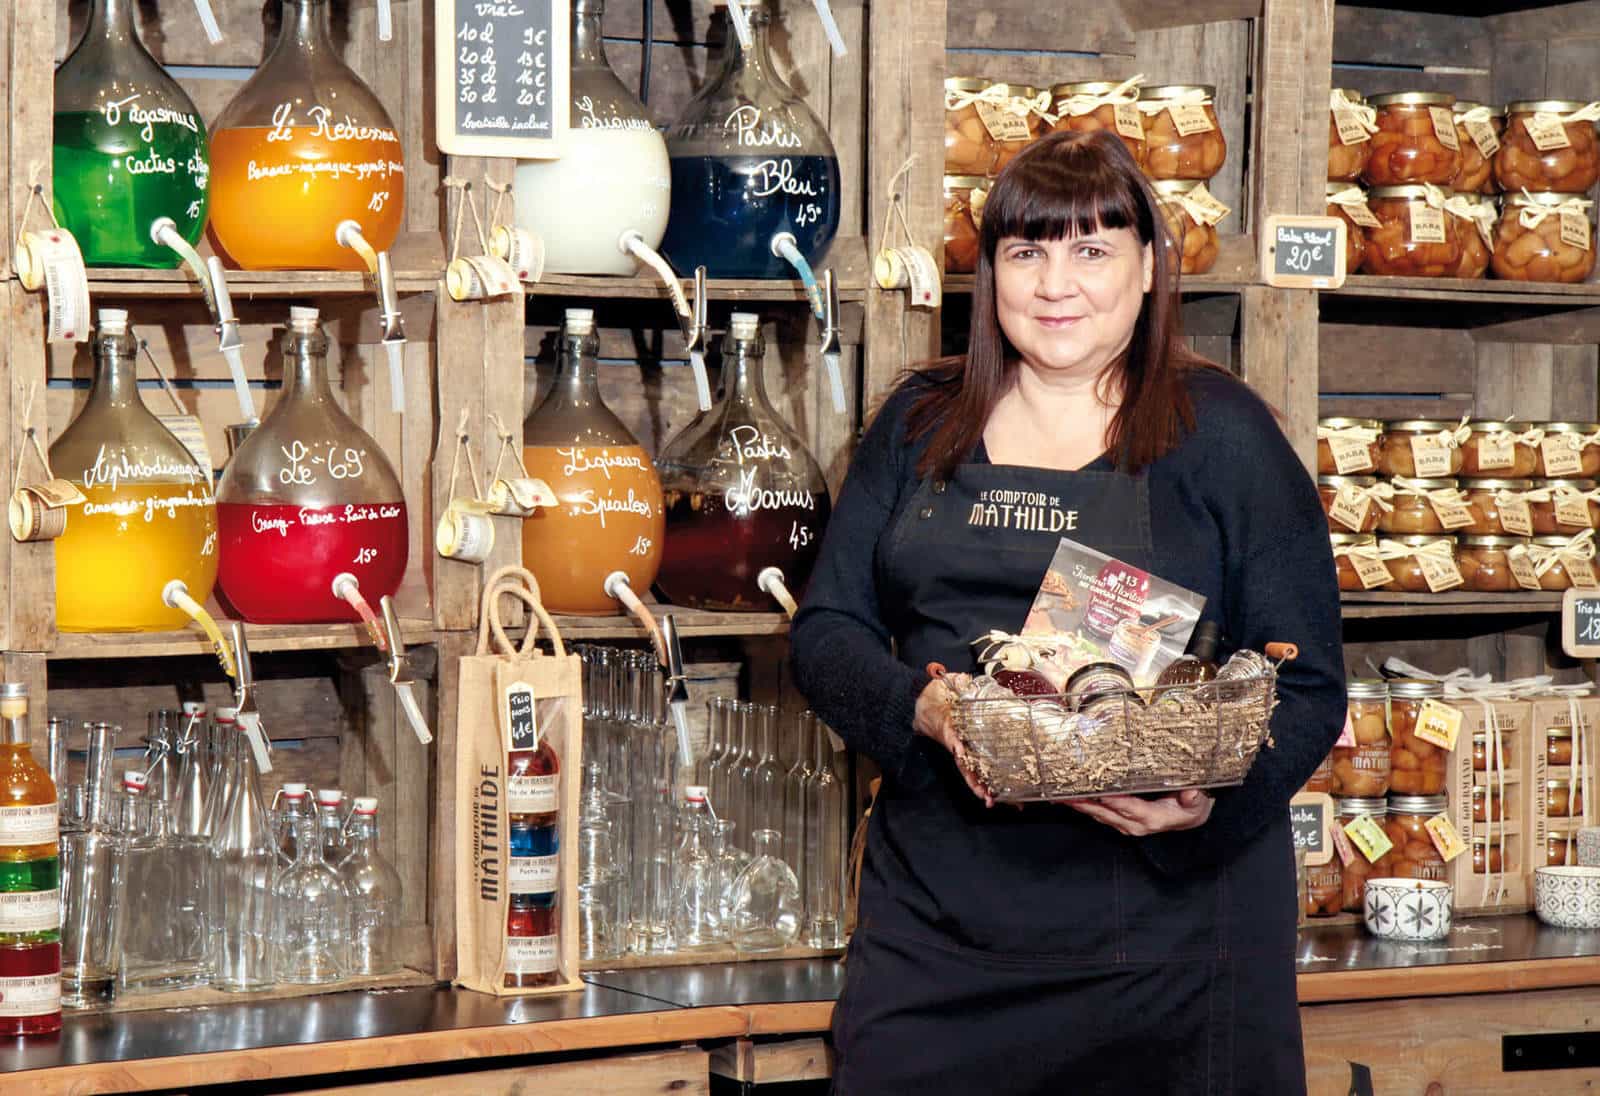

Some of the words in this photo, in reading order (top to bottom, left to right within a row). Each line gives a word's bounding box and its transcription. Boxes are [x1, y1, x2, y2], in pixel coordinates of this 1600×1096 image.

[457, 22, 478, 41] 10
[459, 47, 479, 65] 20
[459, 68, 476, 86] 35
[459, 85, 478, 104] 50
[725, 105, 802, 148] Pastis
[1285, 246, 1323, 271] 20€
[730, 425, 792, 465] Pastis
[980, 491, 988, 501] LE
[990, 489, 1047, 507] COMPTOIR
[1050, 497, 1061, 507] DE
[968, 503, 1079, 533] MATHILDE
[1575, 600, 1594, 616] Trio
[471, 802, 480, 869] COMPTOIR
[480, 764, 499, 902] MATHILDE
